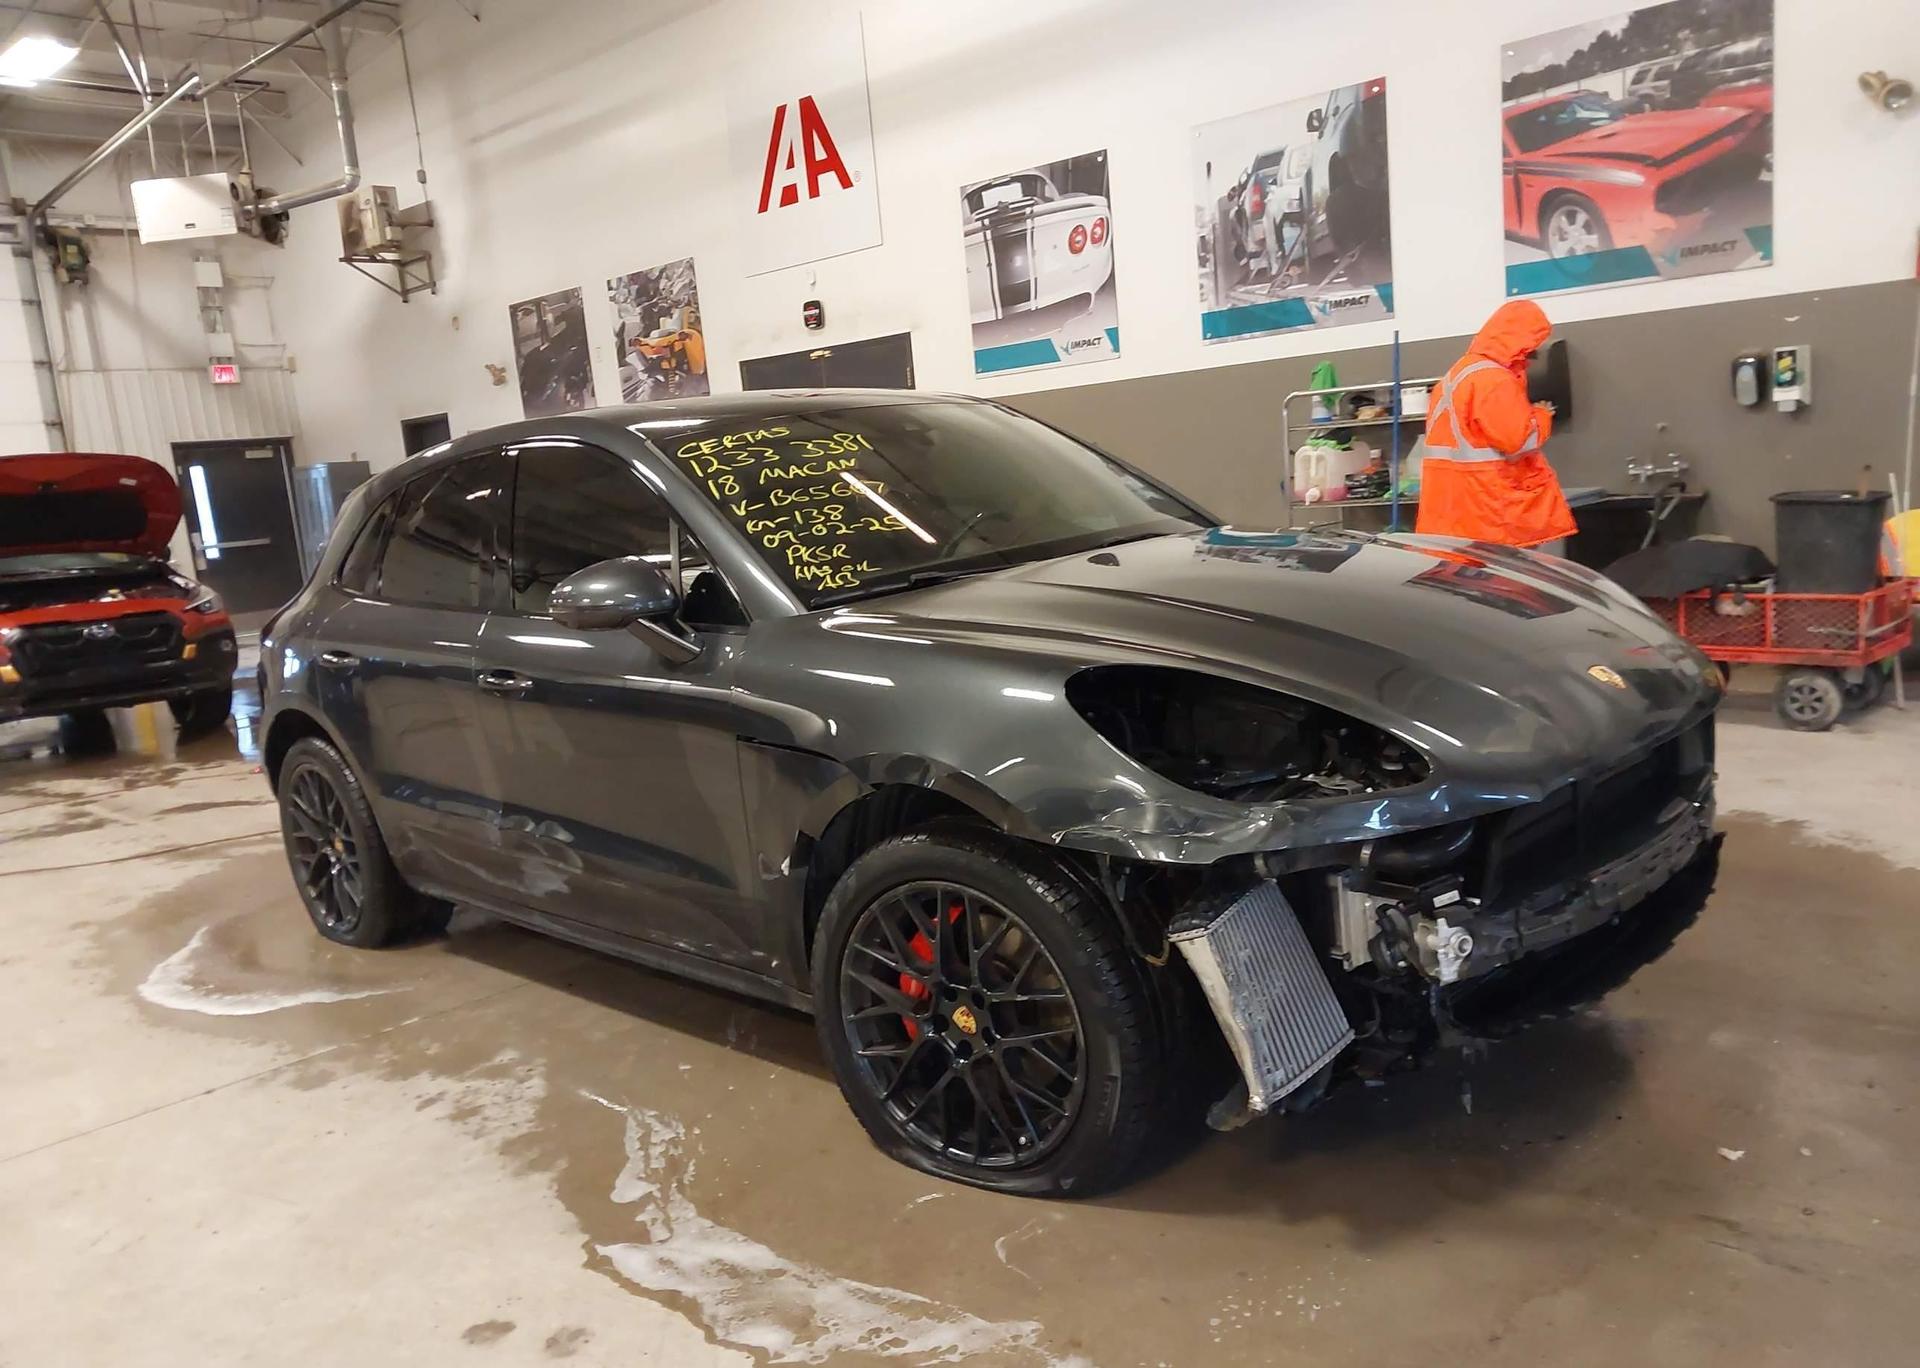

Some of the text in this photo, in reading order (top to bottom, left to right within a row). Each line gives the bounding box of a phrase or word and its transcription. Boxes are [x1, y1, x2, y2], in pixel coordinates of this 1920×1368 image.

[1680, 239, 1738, 258] IMPACT
[1328, 294, 1371, 310] IMPACT
[1070, 336, 1103, 350] IMPACT
[677, 426, 791, 458] CERTAS
[689, 433, 875, 478] 1233 3381
[707, 457, 857, 500] 18 MACAN
